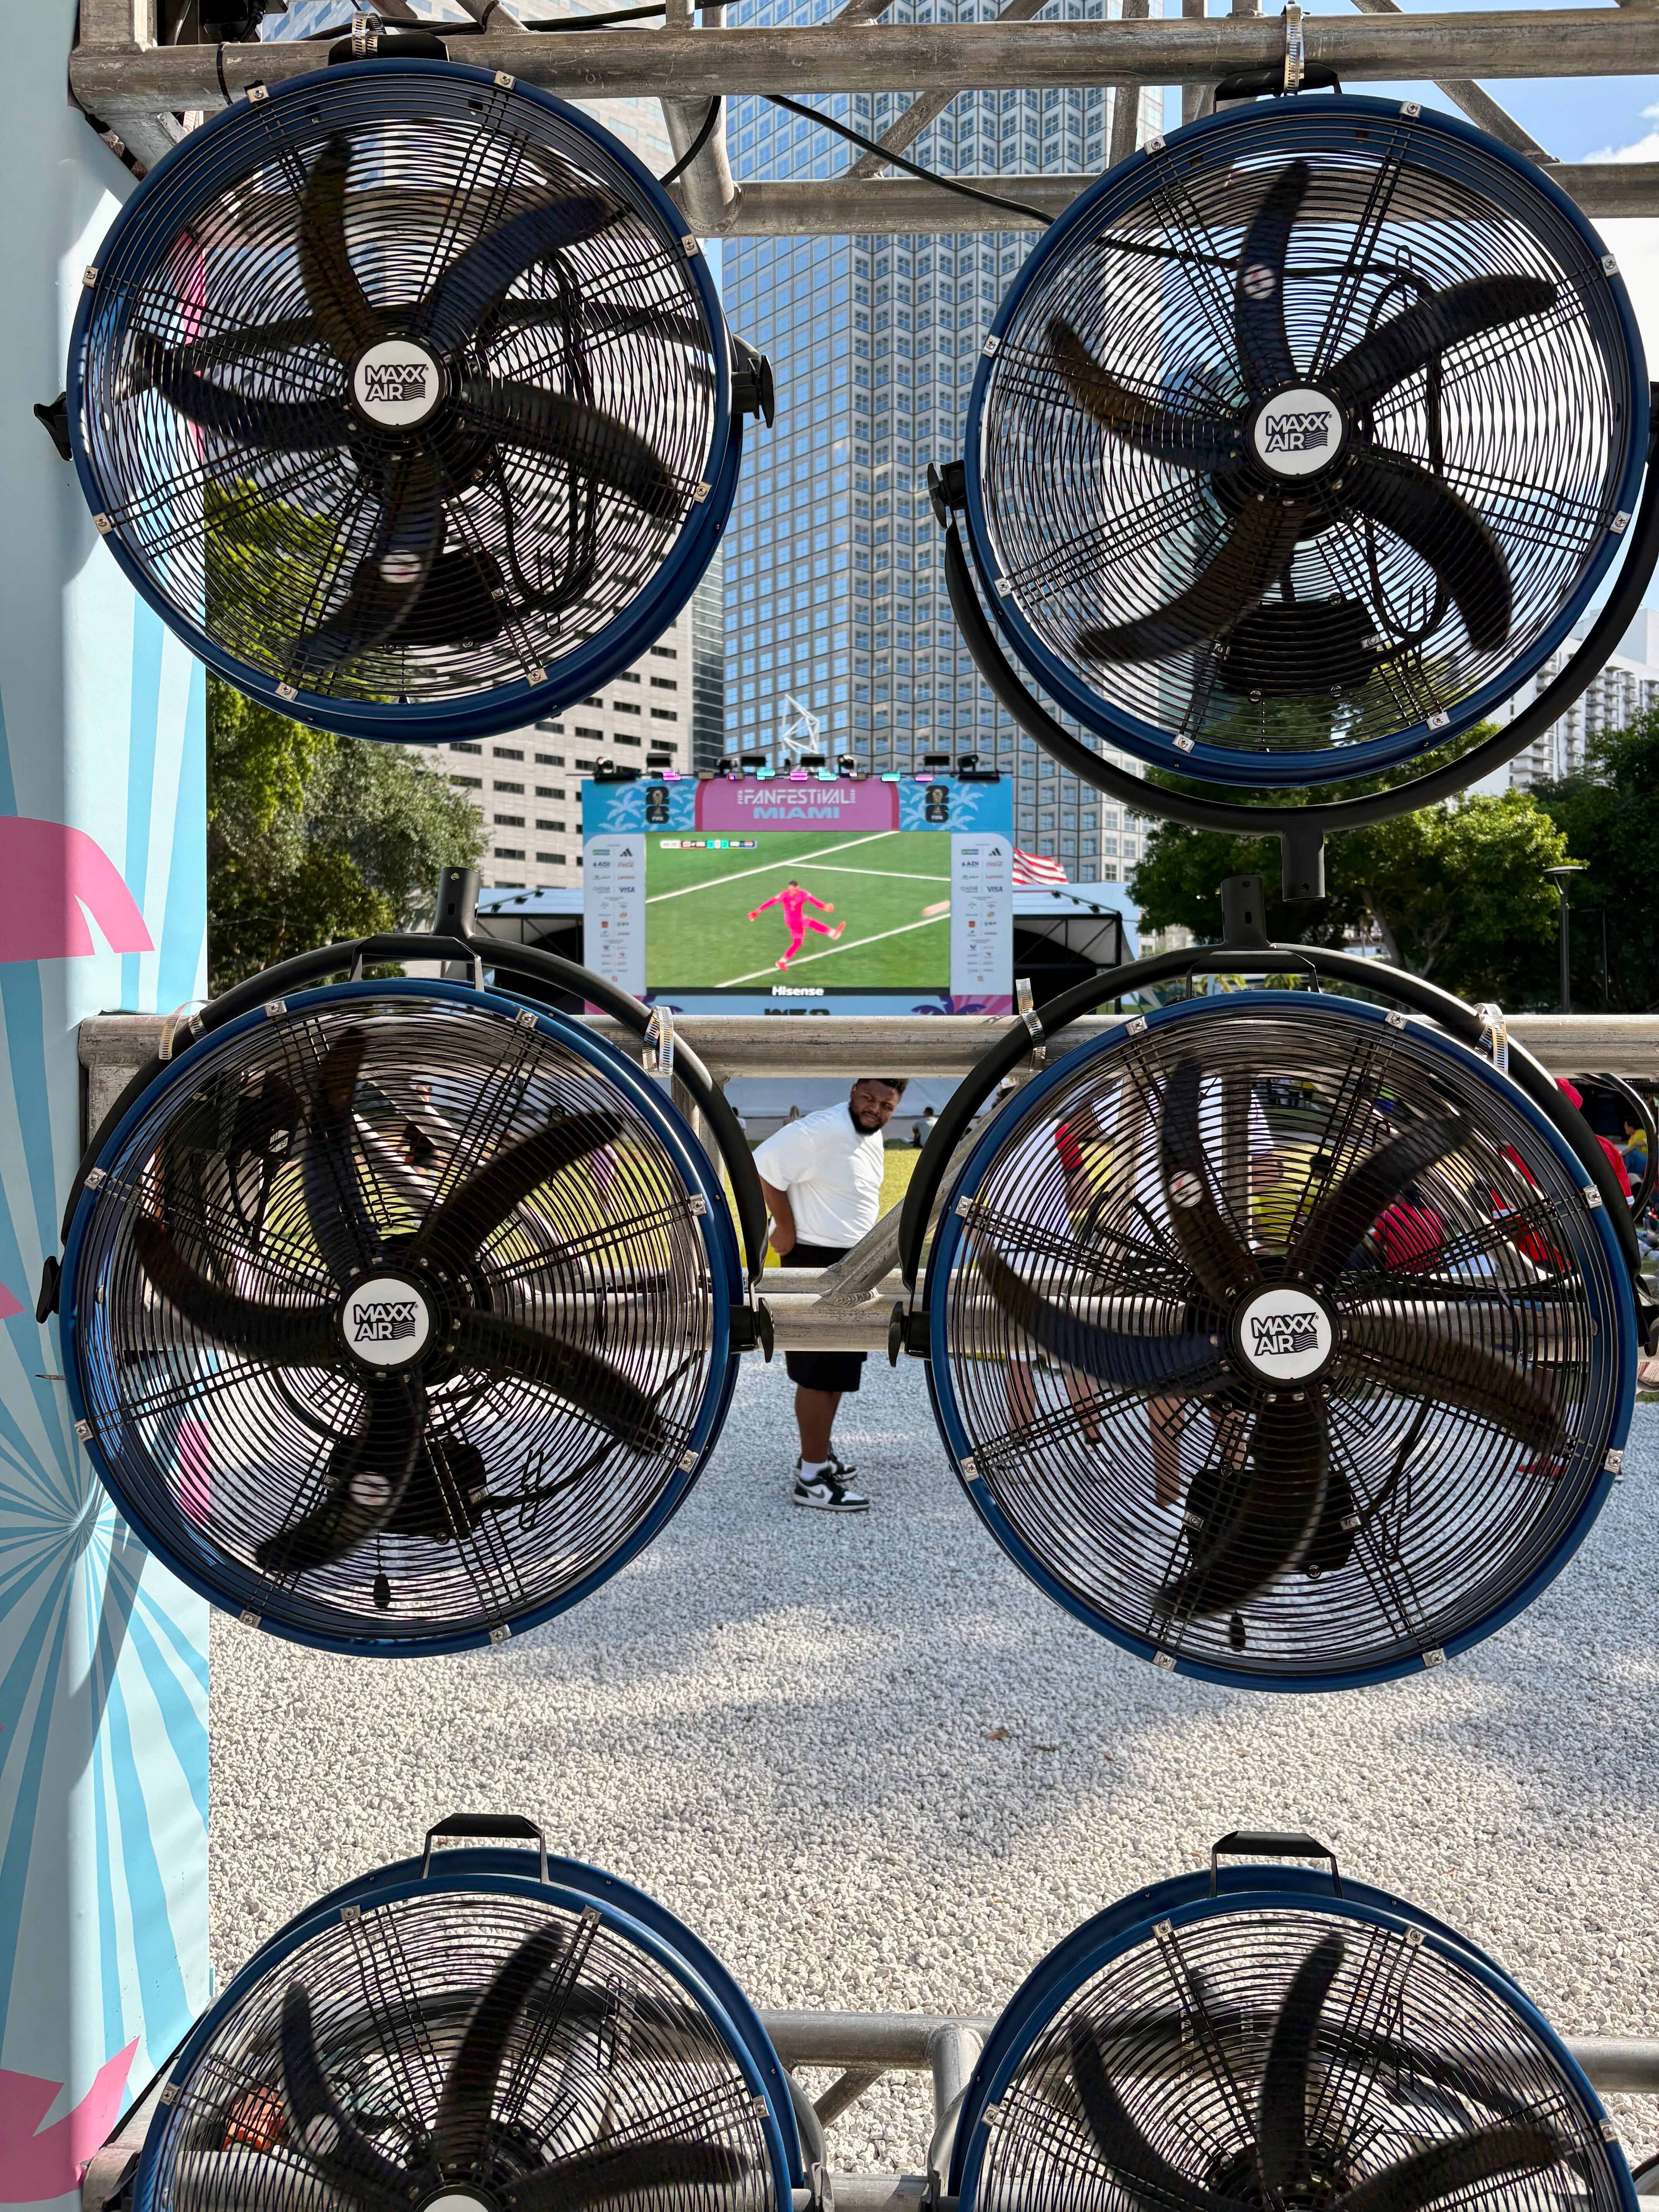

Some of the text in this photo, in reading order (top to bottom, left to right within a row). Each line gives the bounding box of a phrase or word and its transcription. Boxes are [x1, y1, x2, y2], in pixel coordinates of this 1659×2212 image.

[366, 365, 425, 384] MAXX
[366, 383, 405, 401] AIR
[1267, 413, 1328, 435] MAXX
[1266, 433, 1306, 452] AIR
[753, 807, 840, 819] MIAMI
[772, 986, 824, 996] Hisense
[354, 1303, 415, 1324] MAXX
[355, 1322, 394, 1341] AIR
[1252, 1314, 1315, 1337] MAXX
[1255, 1334, 1296, 1355] AIR
